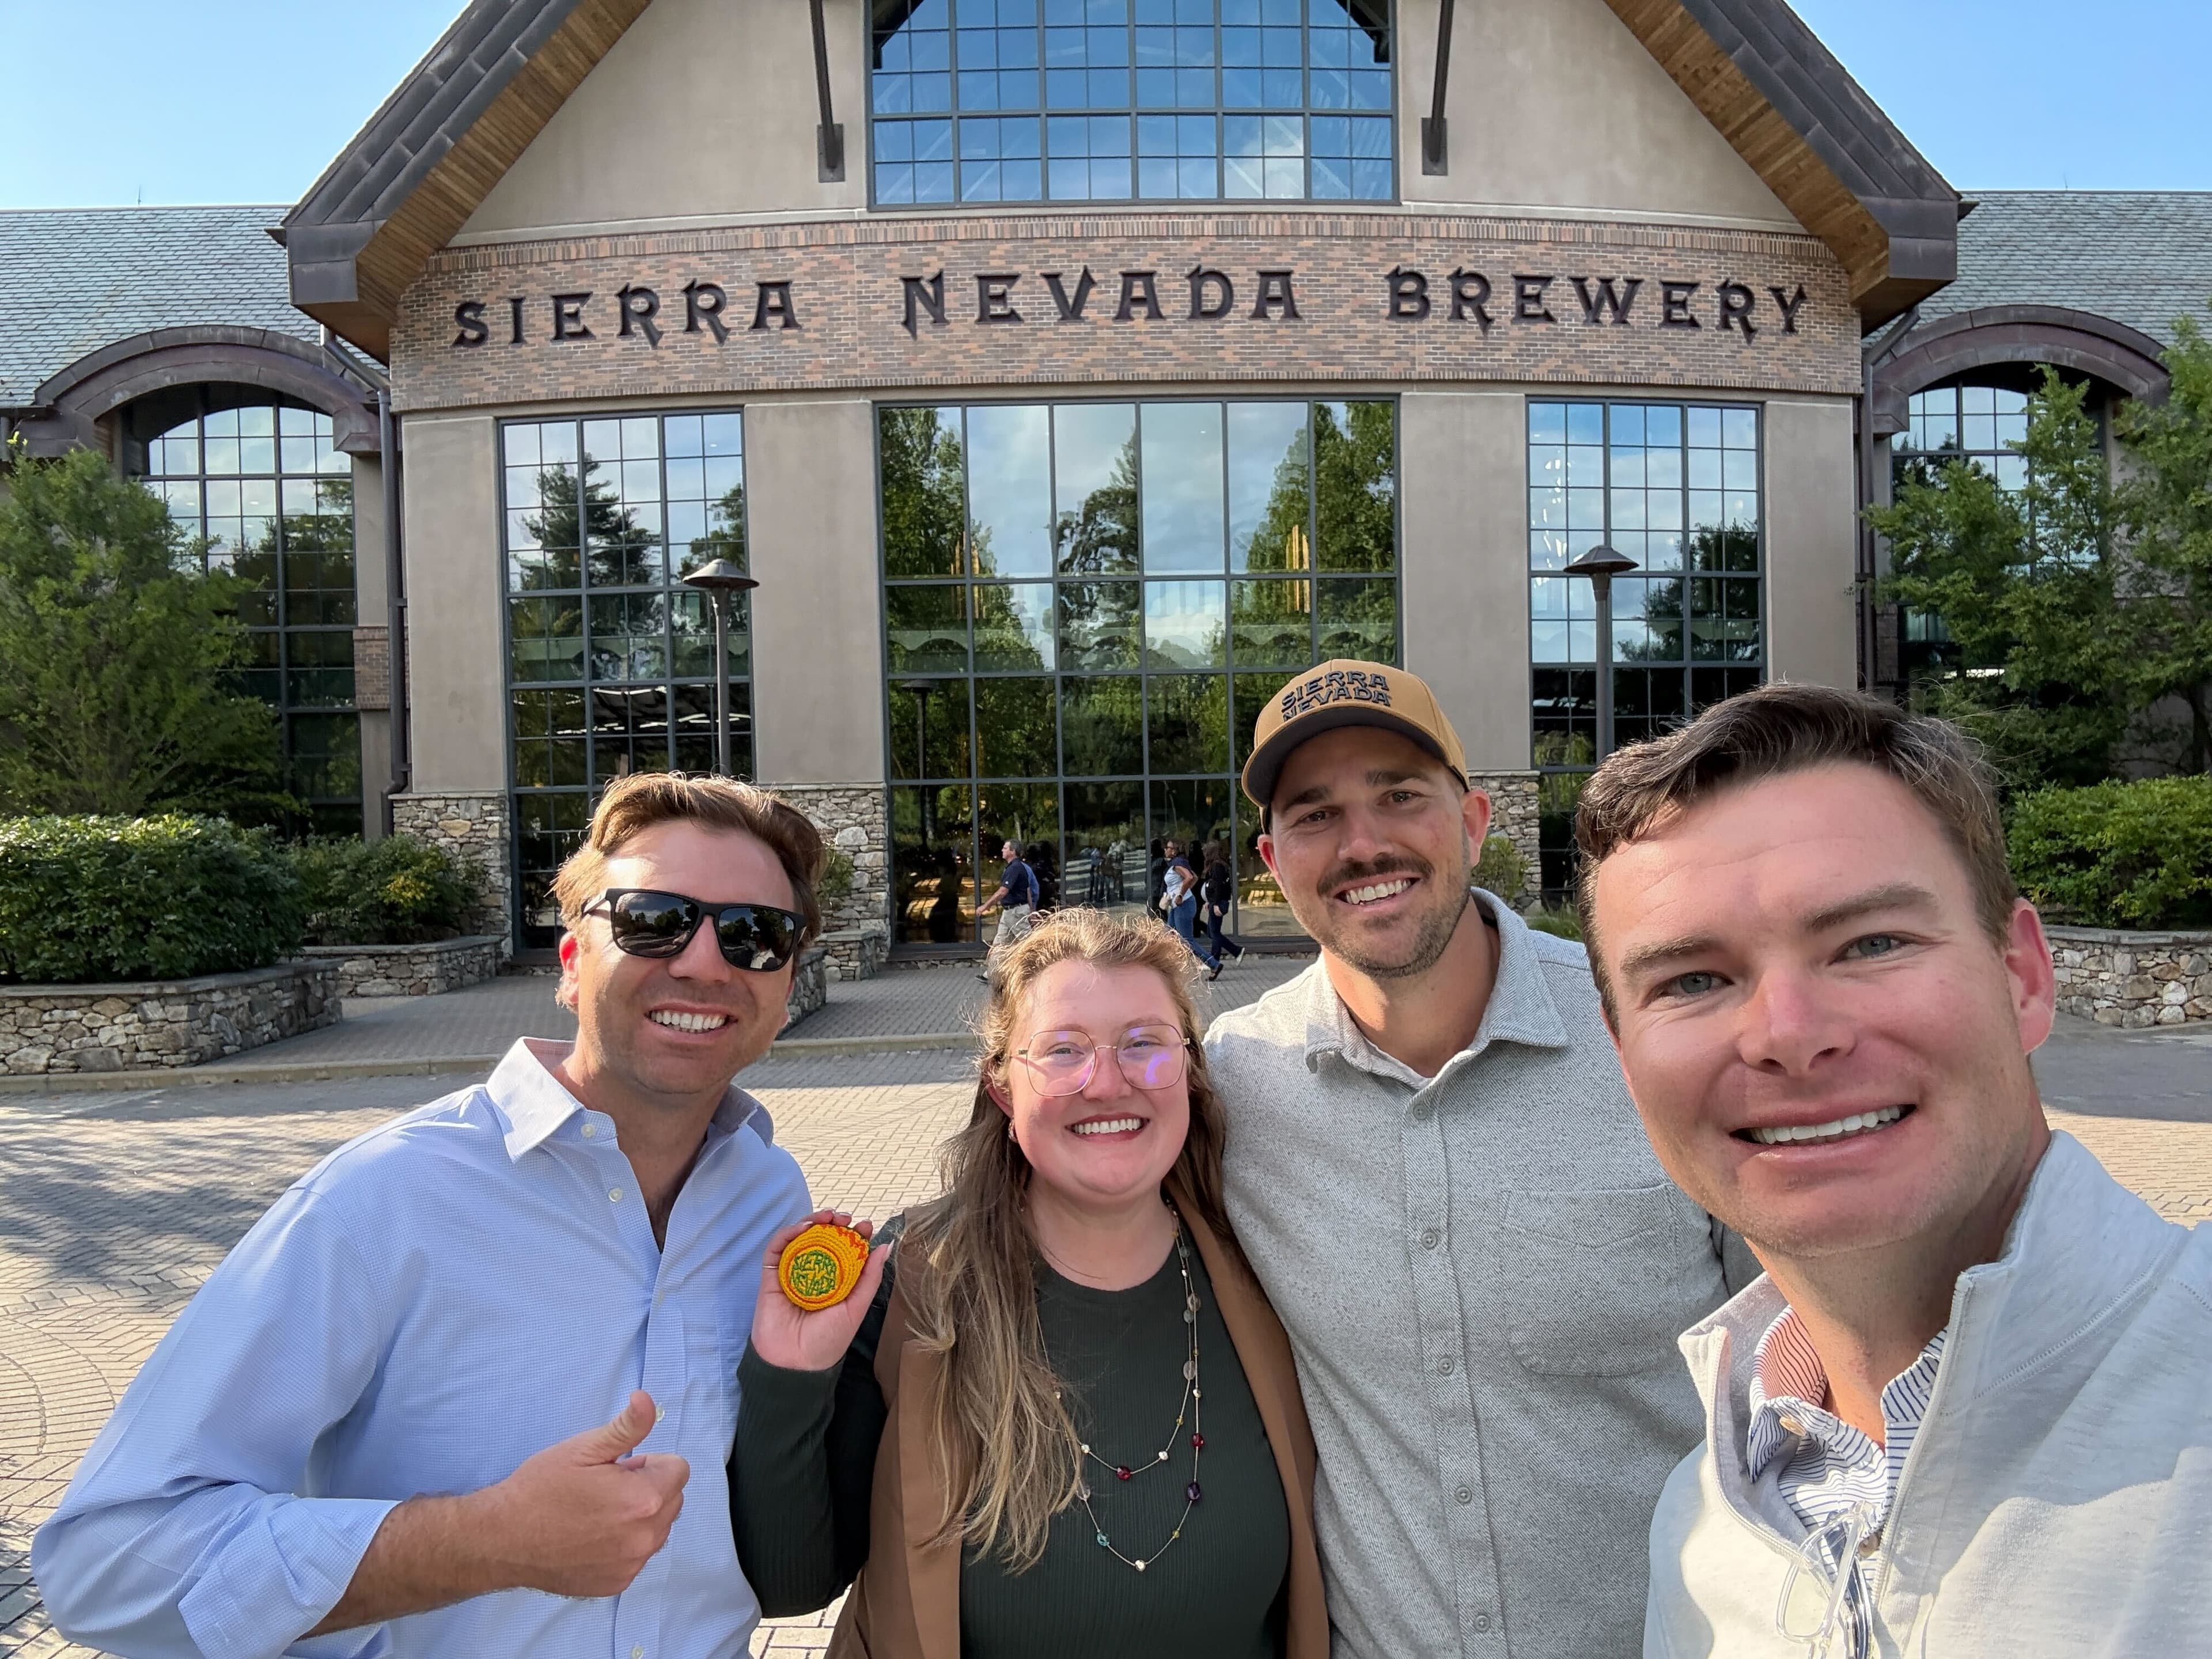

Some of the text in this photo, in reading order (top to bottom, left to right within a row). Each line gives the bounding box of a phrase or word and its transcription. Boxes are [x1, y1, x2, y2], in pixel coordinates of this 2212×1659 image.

[452, 265, 1808, 348] SIERRA NEVADA BREWERY
[1281, 671, 1389, 711] SIERRA
[1283, 686, 1391, 722] NEVADA
